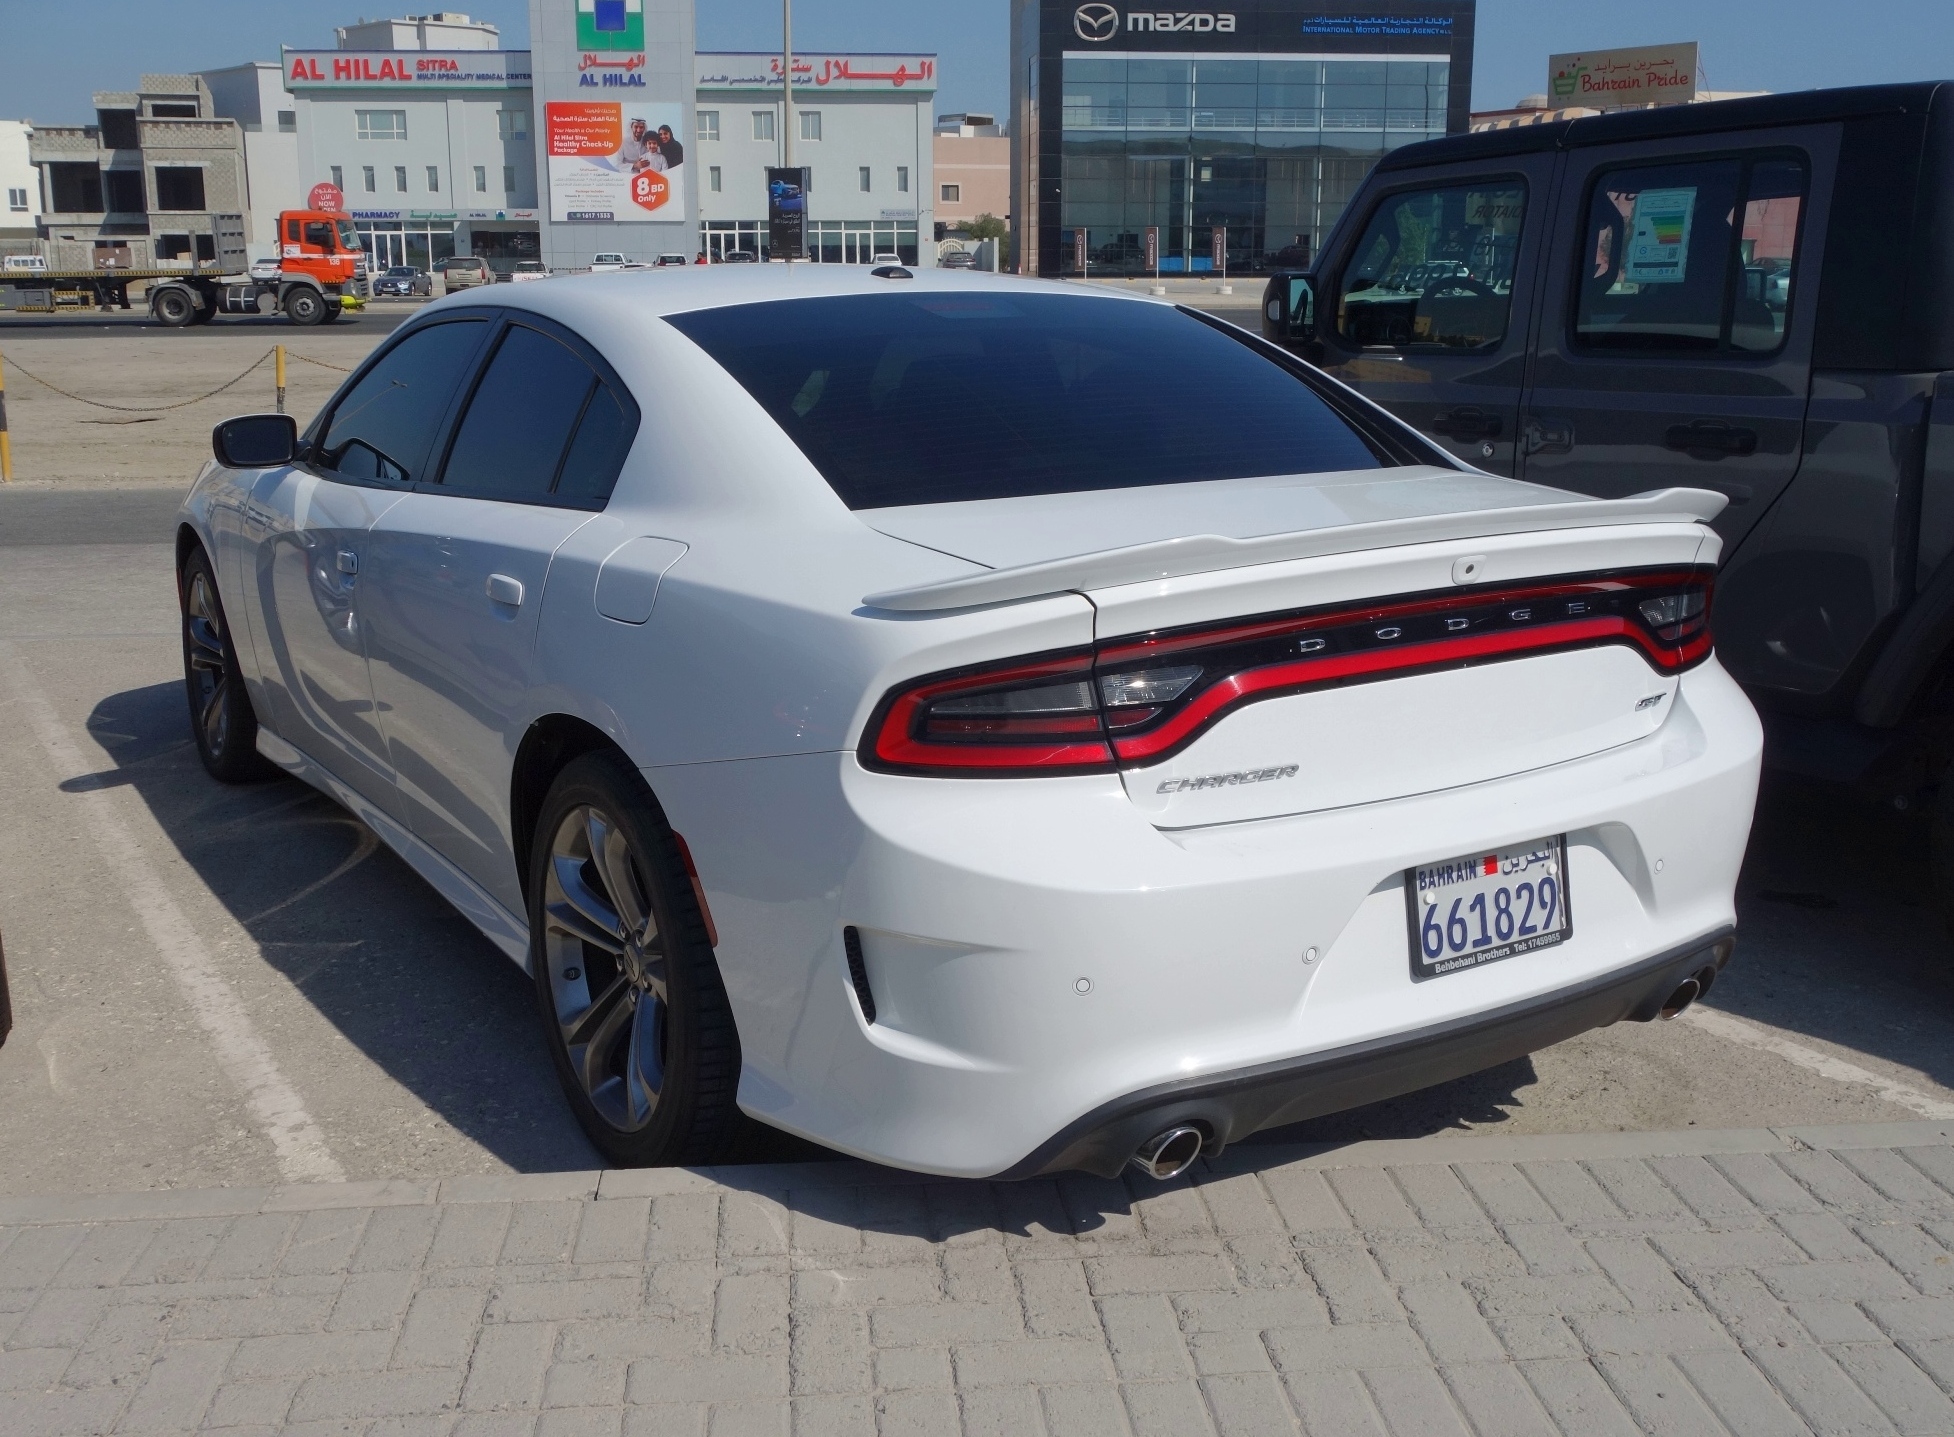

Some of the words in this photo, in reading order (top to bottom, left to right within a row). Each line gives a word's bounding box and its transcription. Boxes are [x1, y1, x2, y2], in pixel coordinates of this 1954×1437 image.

[1314, 16, 1351, 25] للسيارات
[1352, 16, 1389, 26] العالمية
[1390, 16, 1424, 26] التجارية
[1424, 16, 1453, 26] الوكالة
[290, 58, 325, 81] AL
[333, 58, 413, 81] HILAL
[416, 59, 458, 72] SITRA
[577, 53, 646, 72] الهلال
[1594, 58, 1631, 74] برايد
[1634, 58, 1675, 71] بحرين
[416, 73, 436, 81] MULTI
[437, 73, 475, 81] SPECIALITY
[475, 73, 505, 81] MEDICAL
[579, 73, 599, 87] AL
[602, 73, 647, 87] HILAL
[815, 58, 933, 87] الهلال
[1581, 74, 1642, 92] Bahrain
[1646, 69, 1689, 88] Pride
[554, 140, 580, 149] Healthy
[581, 140, 614, 149] Check-Up
[636, 177, 649, 195] 8
[651, 184, 665, 193] BD
[352, 211, 400, 219] PHARMACY
[1300, 602, 1586, 652] DODGE
[1156, 764, 1300, 794] CHARGER
[1502, 841, 1554, 875] البحرين
[1418, 859, 1478, 891] BAHRAIN
[1422, 876, 1557, 959] 661829
[1435, 954, 1476, 974] Behbehani
[1477, 946, 1511, 963] Brothers
[1513, 939, 1528, 953] Tel:
